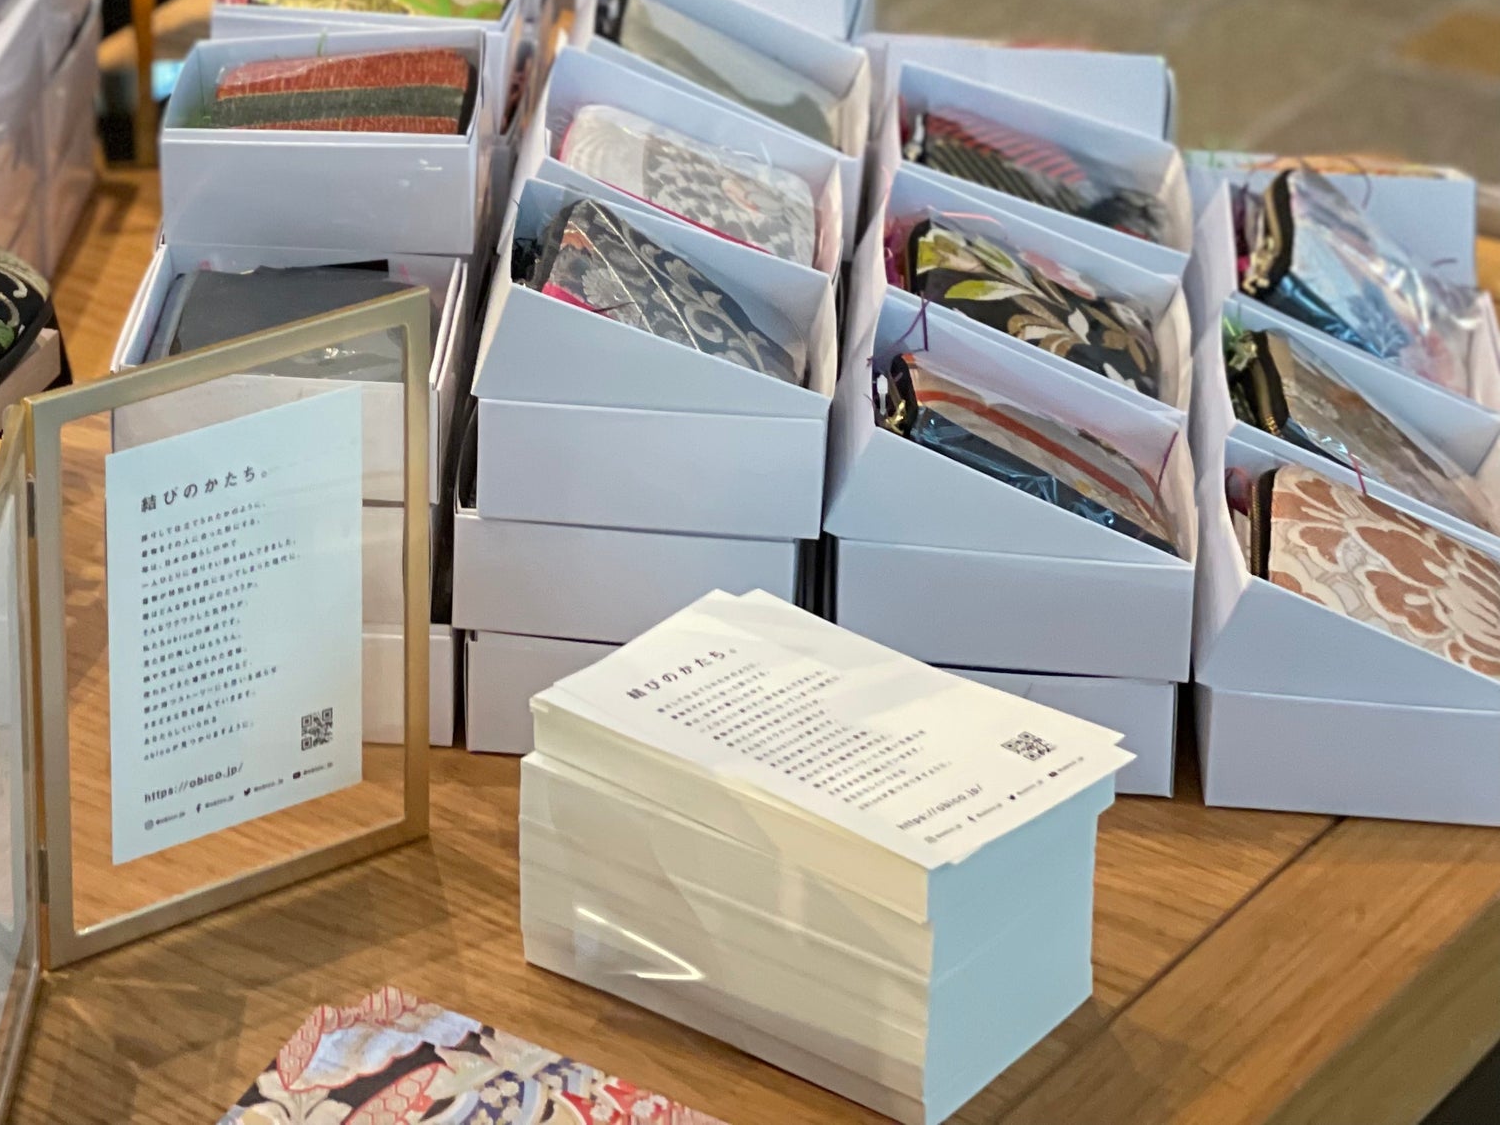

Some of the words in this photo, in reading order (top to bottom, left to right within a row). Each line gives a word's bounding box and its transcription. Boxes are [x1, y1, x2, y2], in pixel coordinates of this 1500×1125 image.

[140, 465, 269, 514] 結びのかたち。
[626, 647, 738, 700] 結びのかたち。
[144, 761, 244, 804] https://obico.jp/
